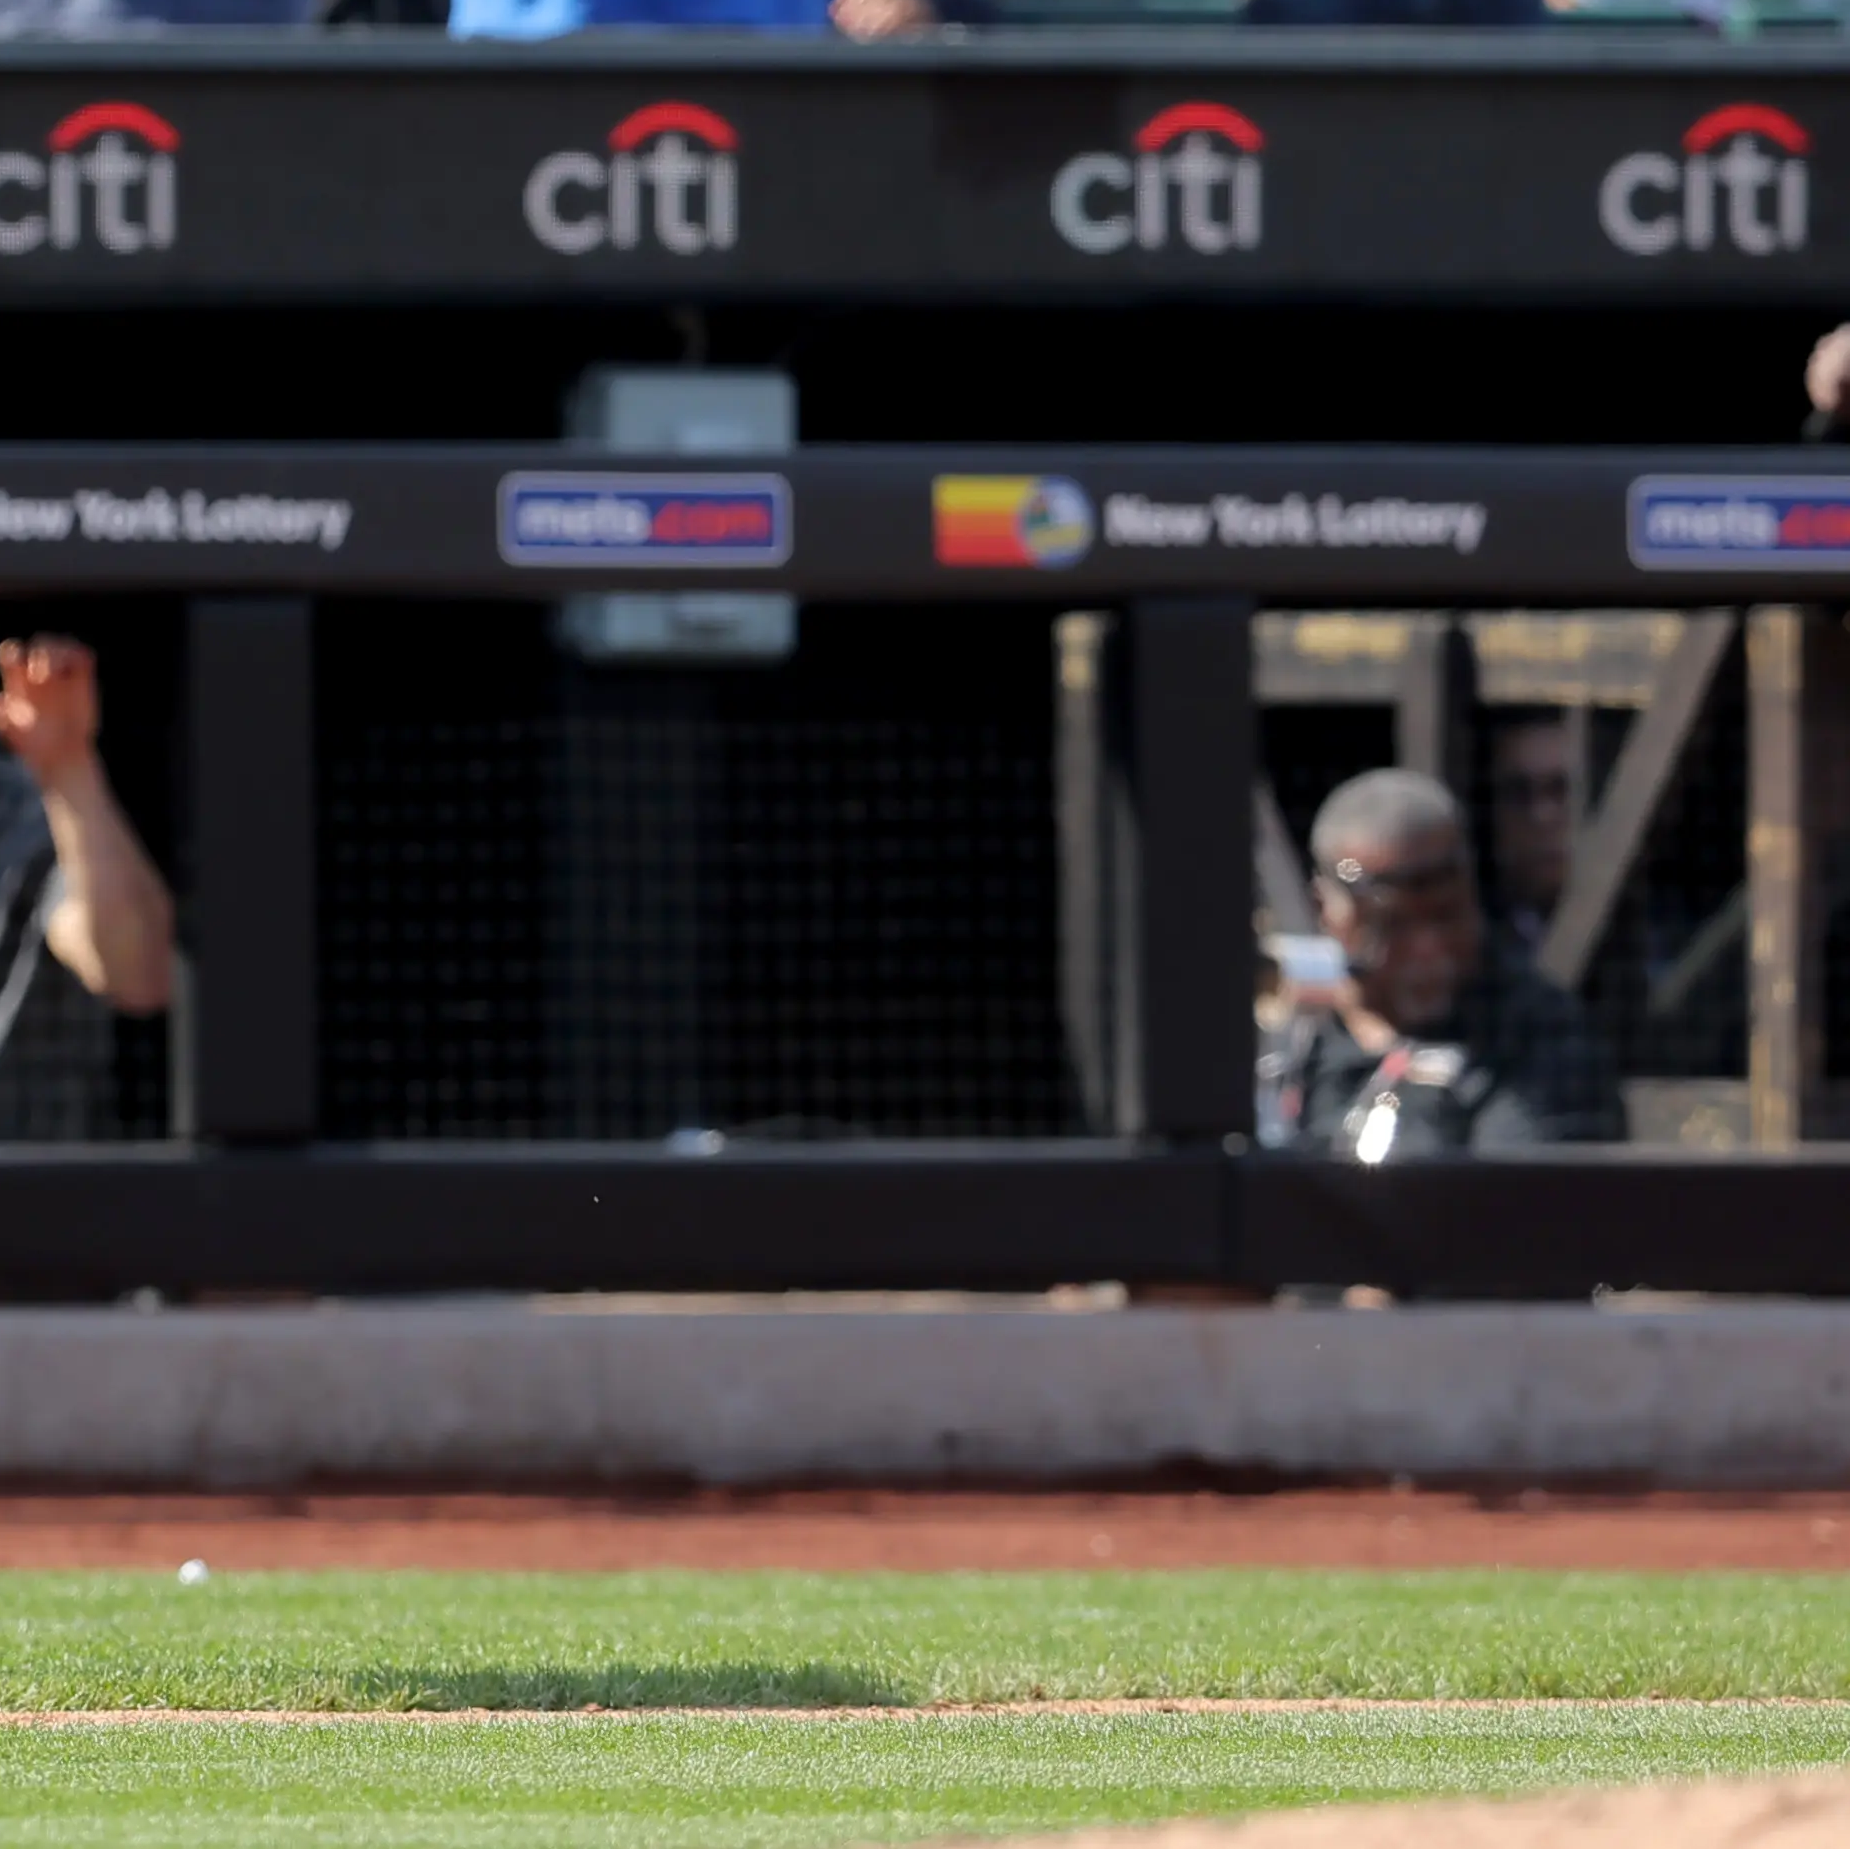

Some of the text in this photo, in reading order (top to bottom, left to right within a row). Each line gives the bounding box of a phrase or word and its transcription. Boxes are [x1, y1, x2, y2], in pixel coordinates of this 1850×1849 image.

[523, 134, 738, 254] citi
[1050, 132, 1262, 254] citi
[1597, 133, 1809, 254] citi
[74, 486, 179, 542] York
[181, 487, 353, 551] Lottery
[1105, 491, 1488, 554] New York Lottery
